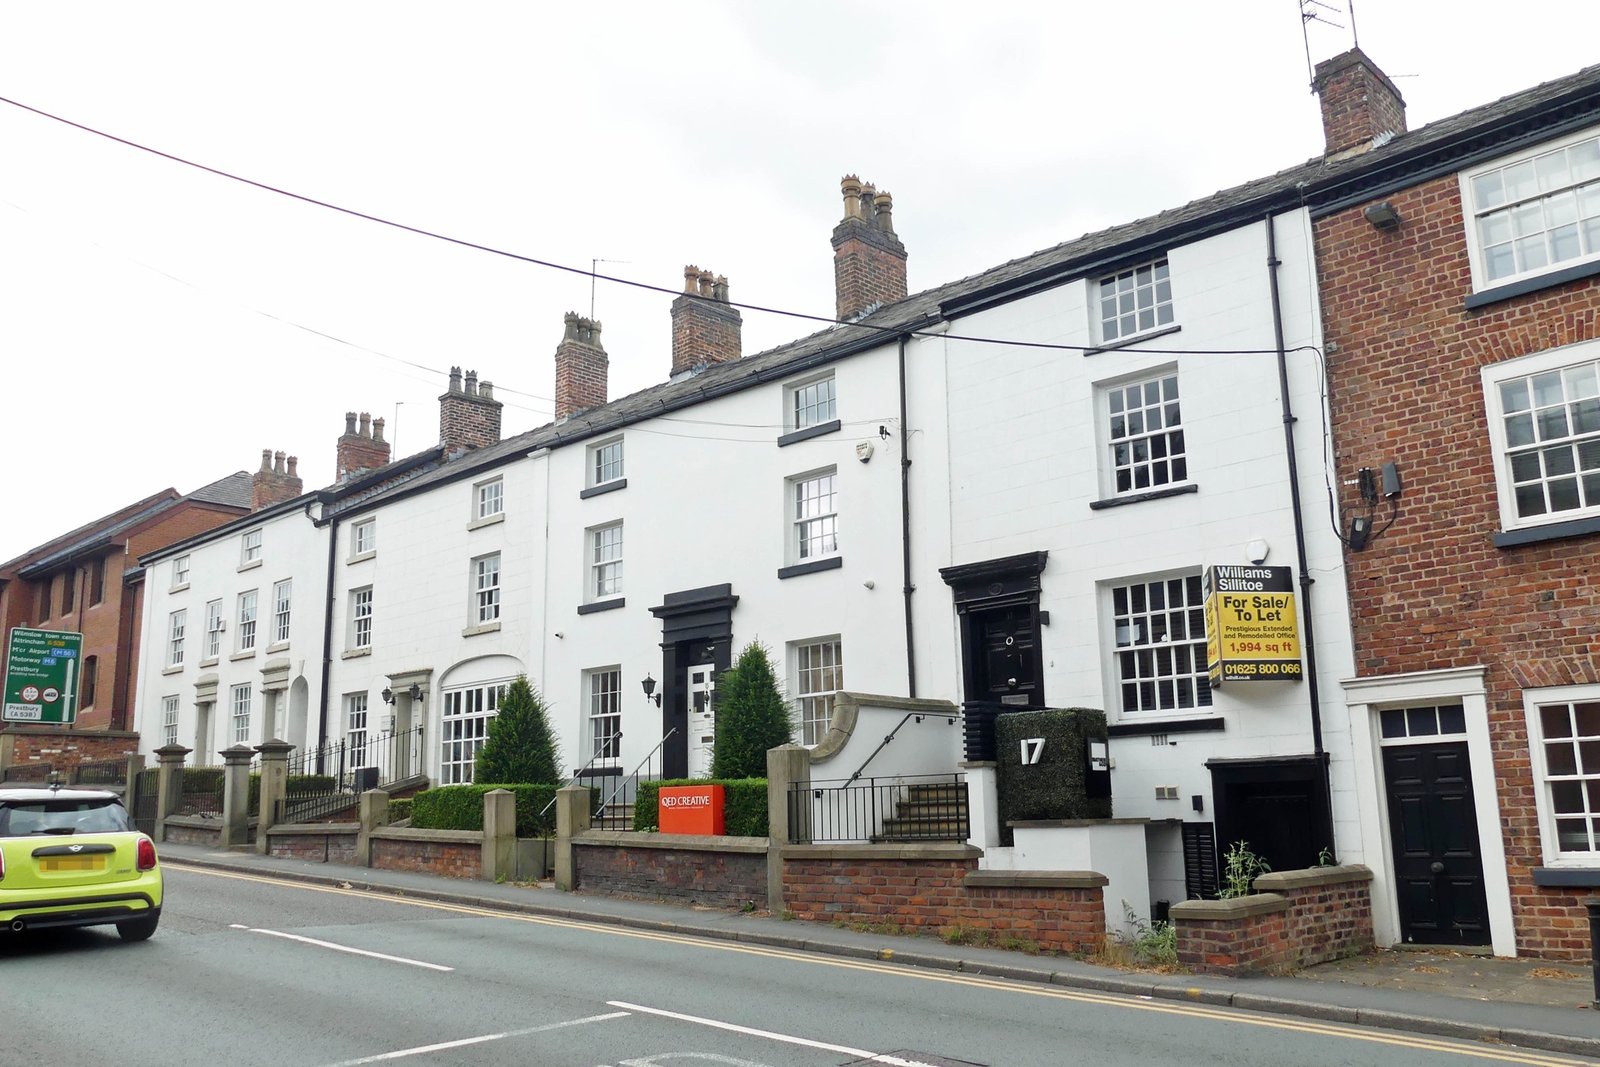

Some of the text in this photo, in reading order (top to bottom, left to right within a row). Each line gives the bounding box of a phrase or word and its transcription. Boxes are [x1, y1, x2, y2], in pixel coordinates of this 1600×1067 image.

[1217, 566, 1272, 579] Williams
[1219, 579, 1263, 591] Sillitoe
[1223, 596, 1289, 609] For Sale/
[1234, 609, 1281, 621] To Let
[1225, 625, 1261, 633] Prestigious
[13, 637, 45, 645] Altrincham
[1230, 641, 1292, 654] 1,994 sq ft
[11, 656, 41, 664] Motorway
[1224, 664, 1257, 675] 01625
[1258, 664, 1279, 674] 800
[1281, 663, 1301, 674] 066
[1020, 738, 1046, 765] 17
[661, 795, 710, 808] QED CREATIVE
